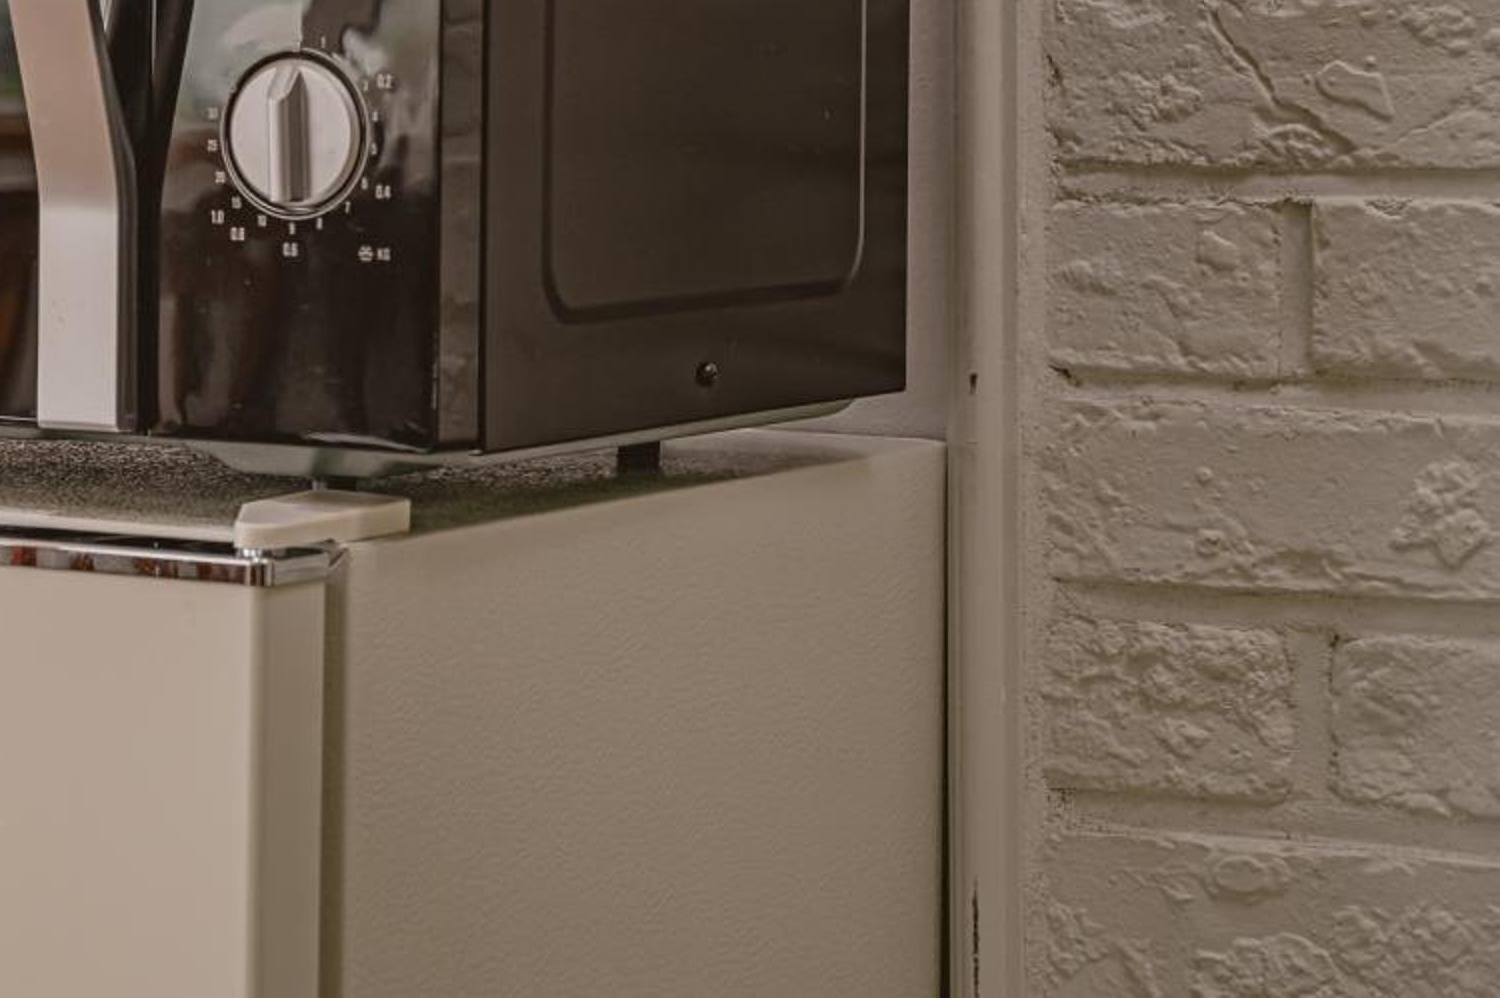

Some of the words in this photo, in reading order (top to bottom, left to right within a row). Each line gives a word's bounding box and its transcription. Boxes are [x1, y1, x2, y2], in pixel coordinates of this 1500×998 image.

[377, 74, 393, 89] 0.2
[375, 185, 391, 199] 0.4
[211, 210, 225, 225] 1.0
